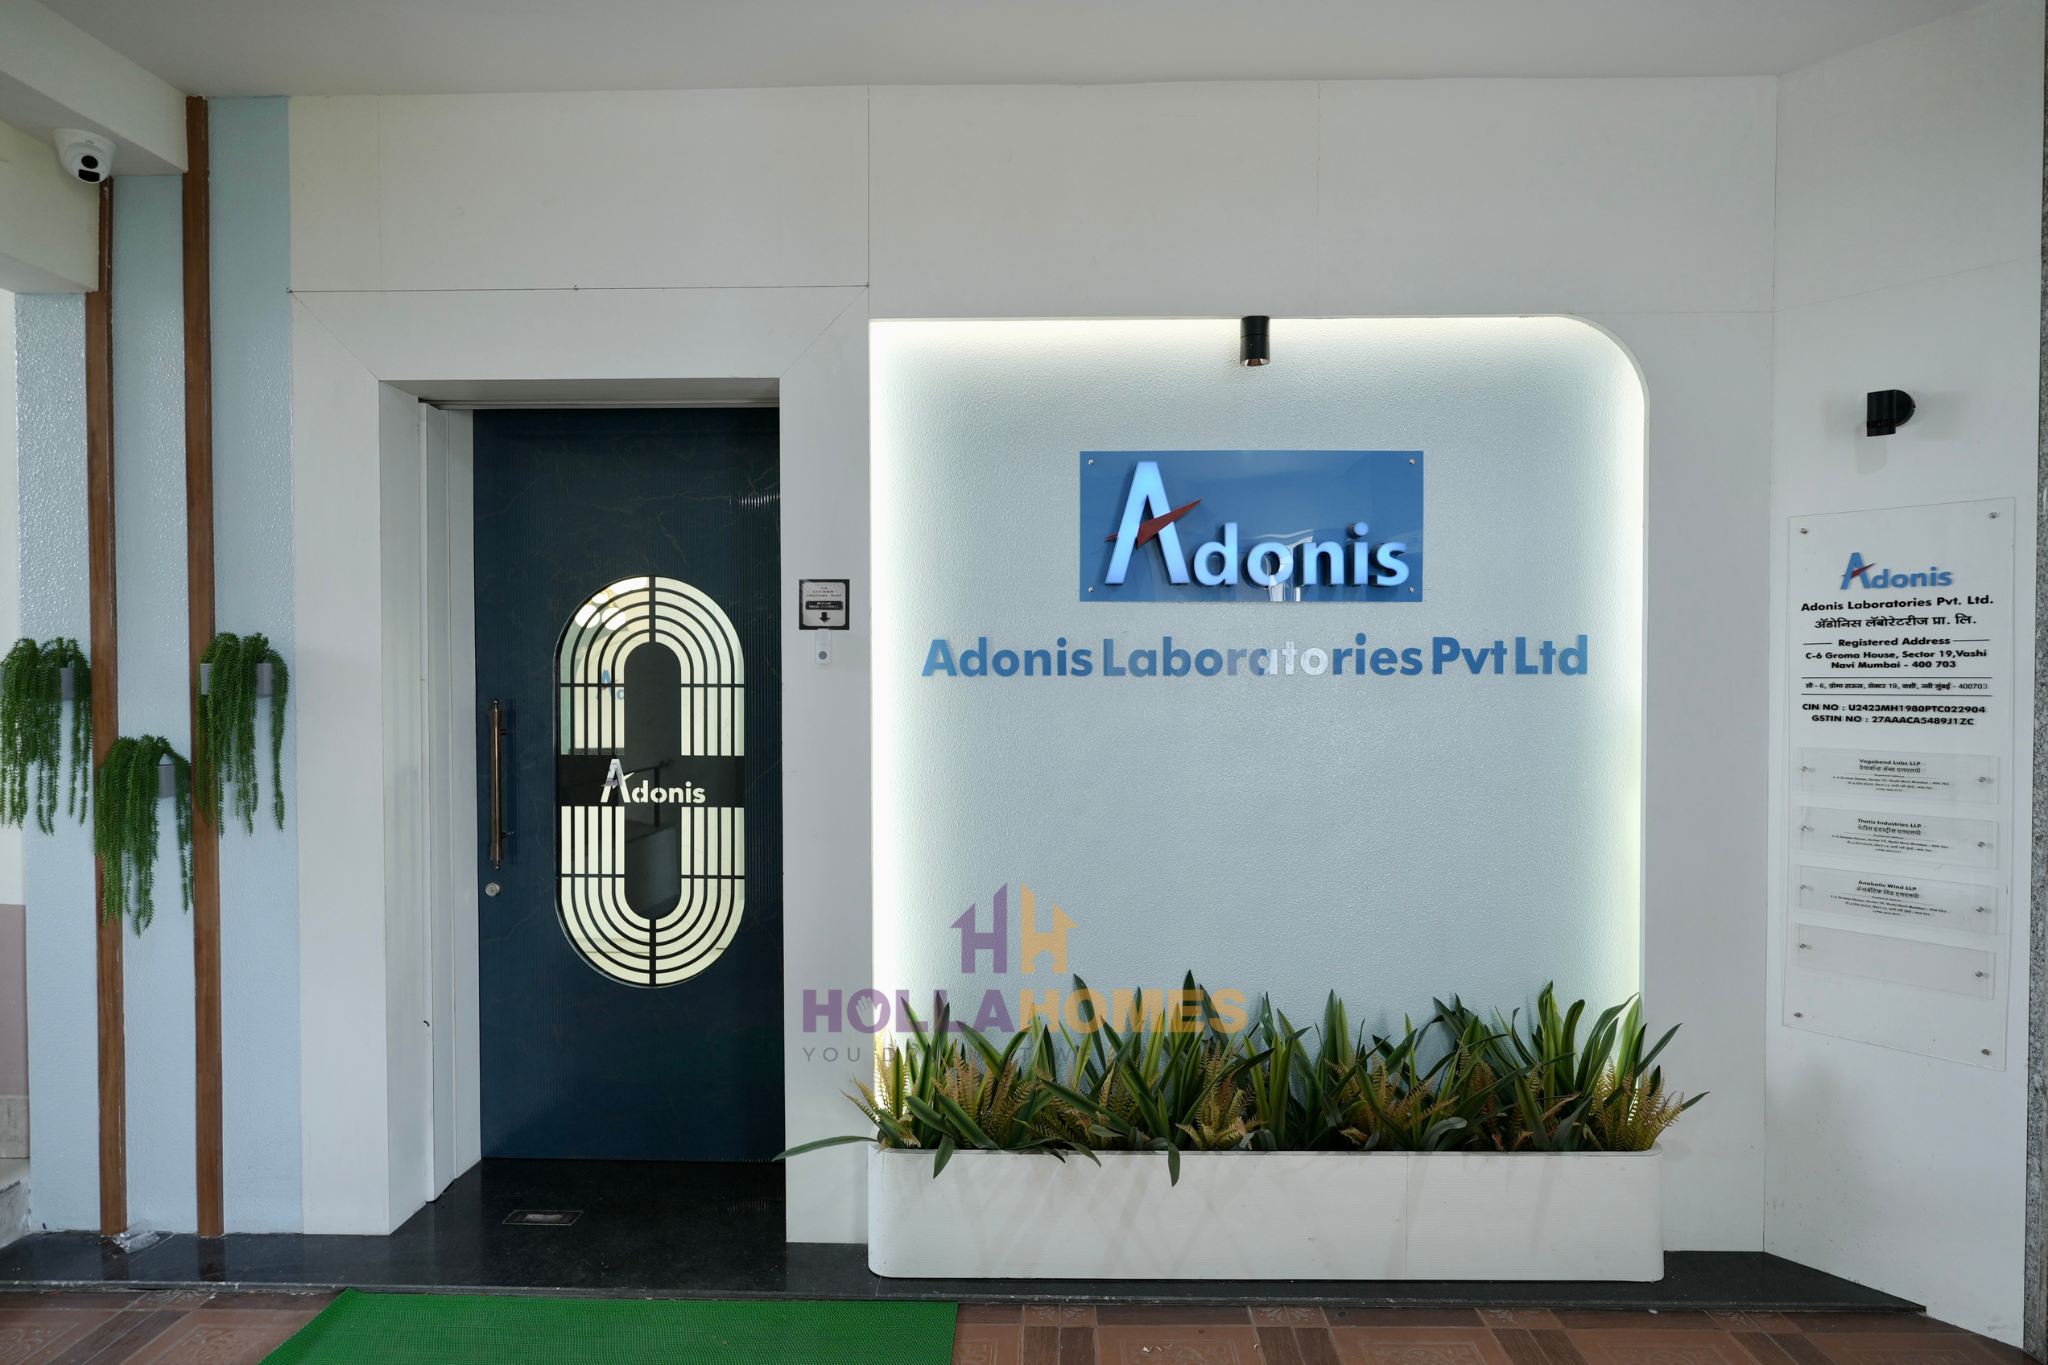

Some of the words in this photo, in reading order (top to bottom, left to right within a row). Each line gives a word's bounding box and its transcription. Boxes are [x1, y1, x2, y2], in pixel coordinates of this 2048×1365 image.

[1104, 460, 1410, 587] Adonis
[1840, 552, 1952, 590] Adonis
[1801, 602, 1843, 612] Adonis
[1848, 598, 1932, 610] Laboratories
[1937, 597, 1962, 606] Pvt.
[1967, 595, 1994, 605] Ltd.
[1838, 638, 1898, 648] Registered
[1902, 637, 1951, 646] Address
[922, 637, 1092, 677] Adonis
[1103, 633, 1423, 677] Laboratories
[1432, 636, 1506, 675] Pvt
[1515, 635, 1588, 675] Ltd
[1805, 652, 1822, 660] C-6
[1863, 651, 1899, 660] House,
[1902, 650, 1936, 658] Sector
[1831, 661, 1855, 669] Navi
[1858, 661, 1901, 669] Mumbai
[1936, 660, 1956, 668] 703
[1802, 703, 1820, 711] CIN
[1848, 704, 1986, 713] U2423MH1980PTC022904
[1845, 715, 1862, 723] NO
[600, 758, 706, 804] Adonis
[1877, 820, 1909, 828] Industries
